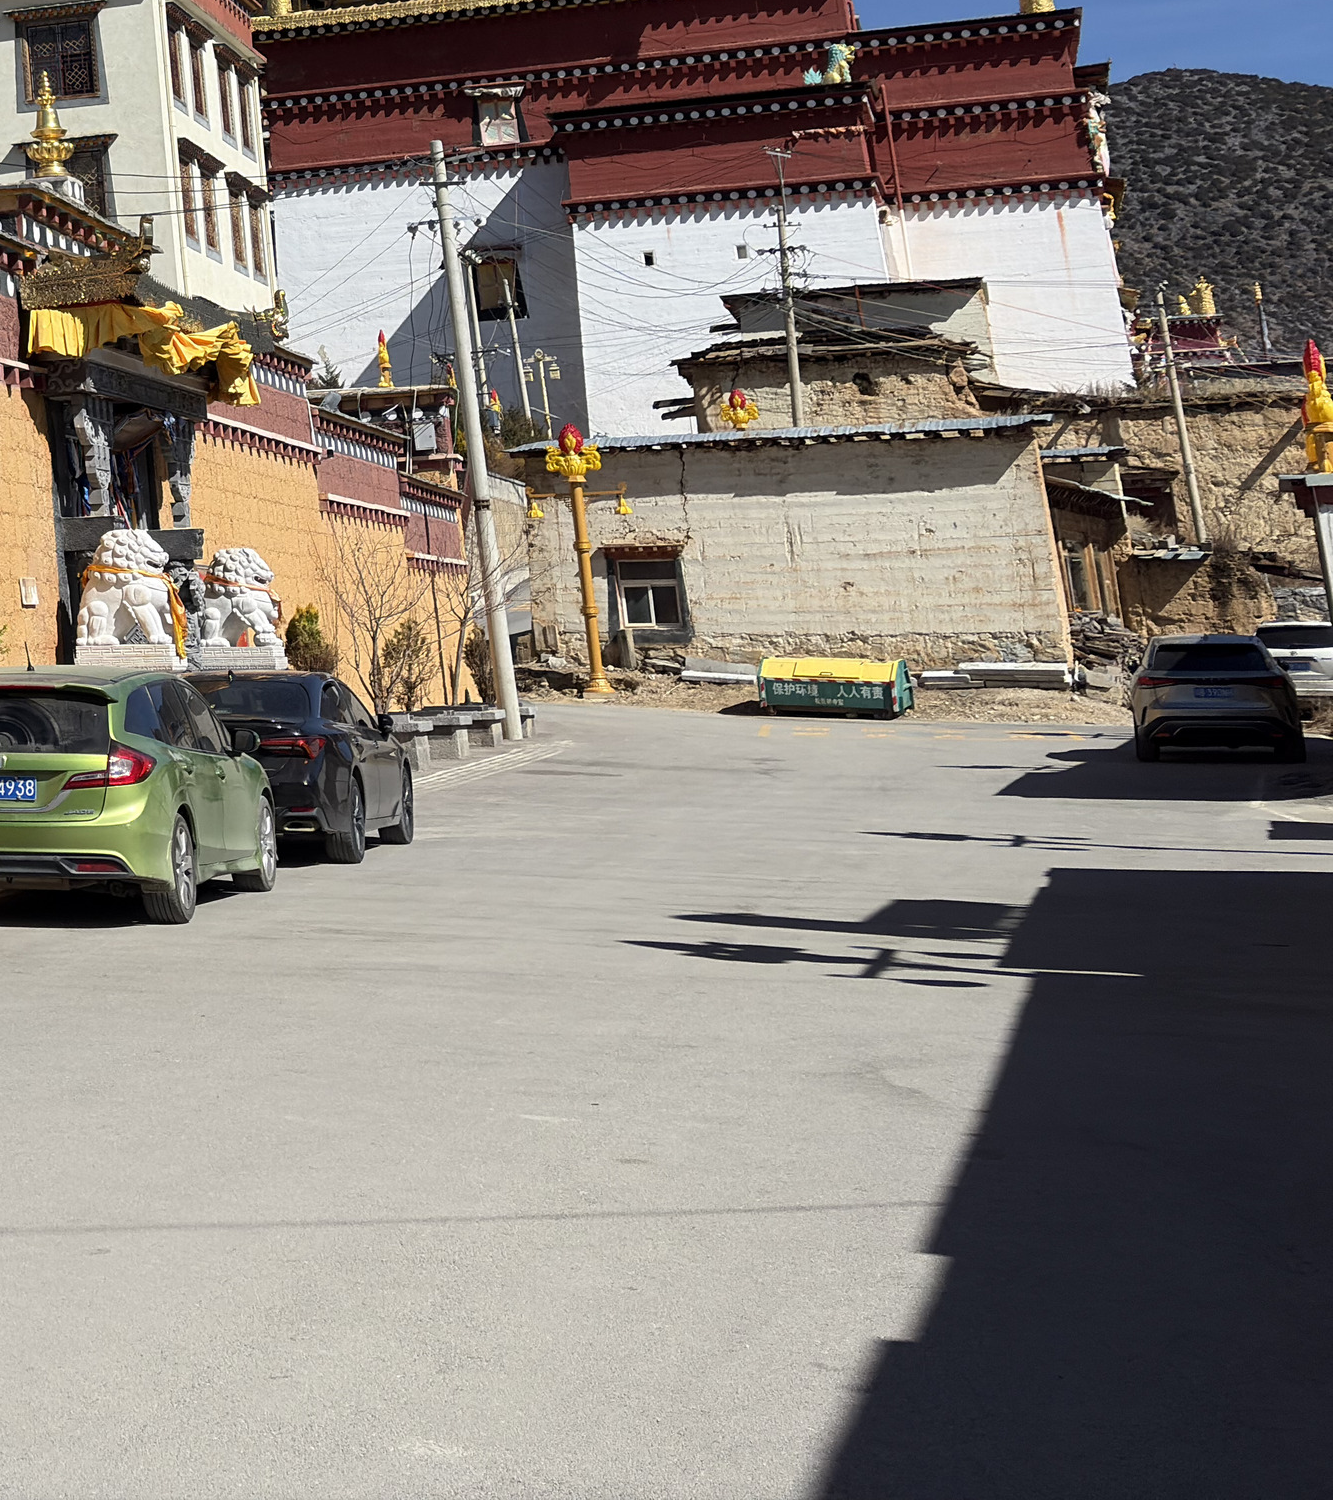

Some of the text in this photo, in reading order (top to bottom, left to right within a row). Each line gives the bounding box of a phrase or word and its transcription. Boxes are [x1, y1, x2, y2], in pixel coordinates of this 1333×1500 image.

[773, 682, 884, 699] 保护环境 人人有责
